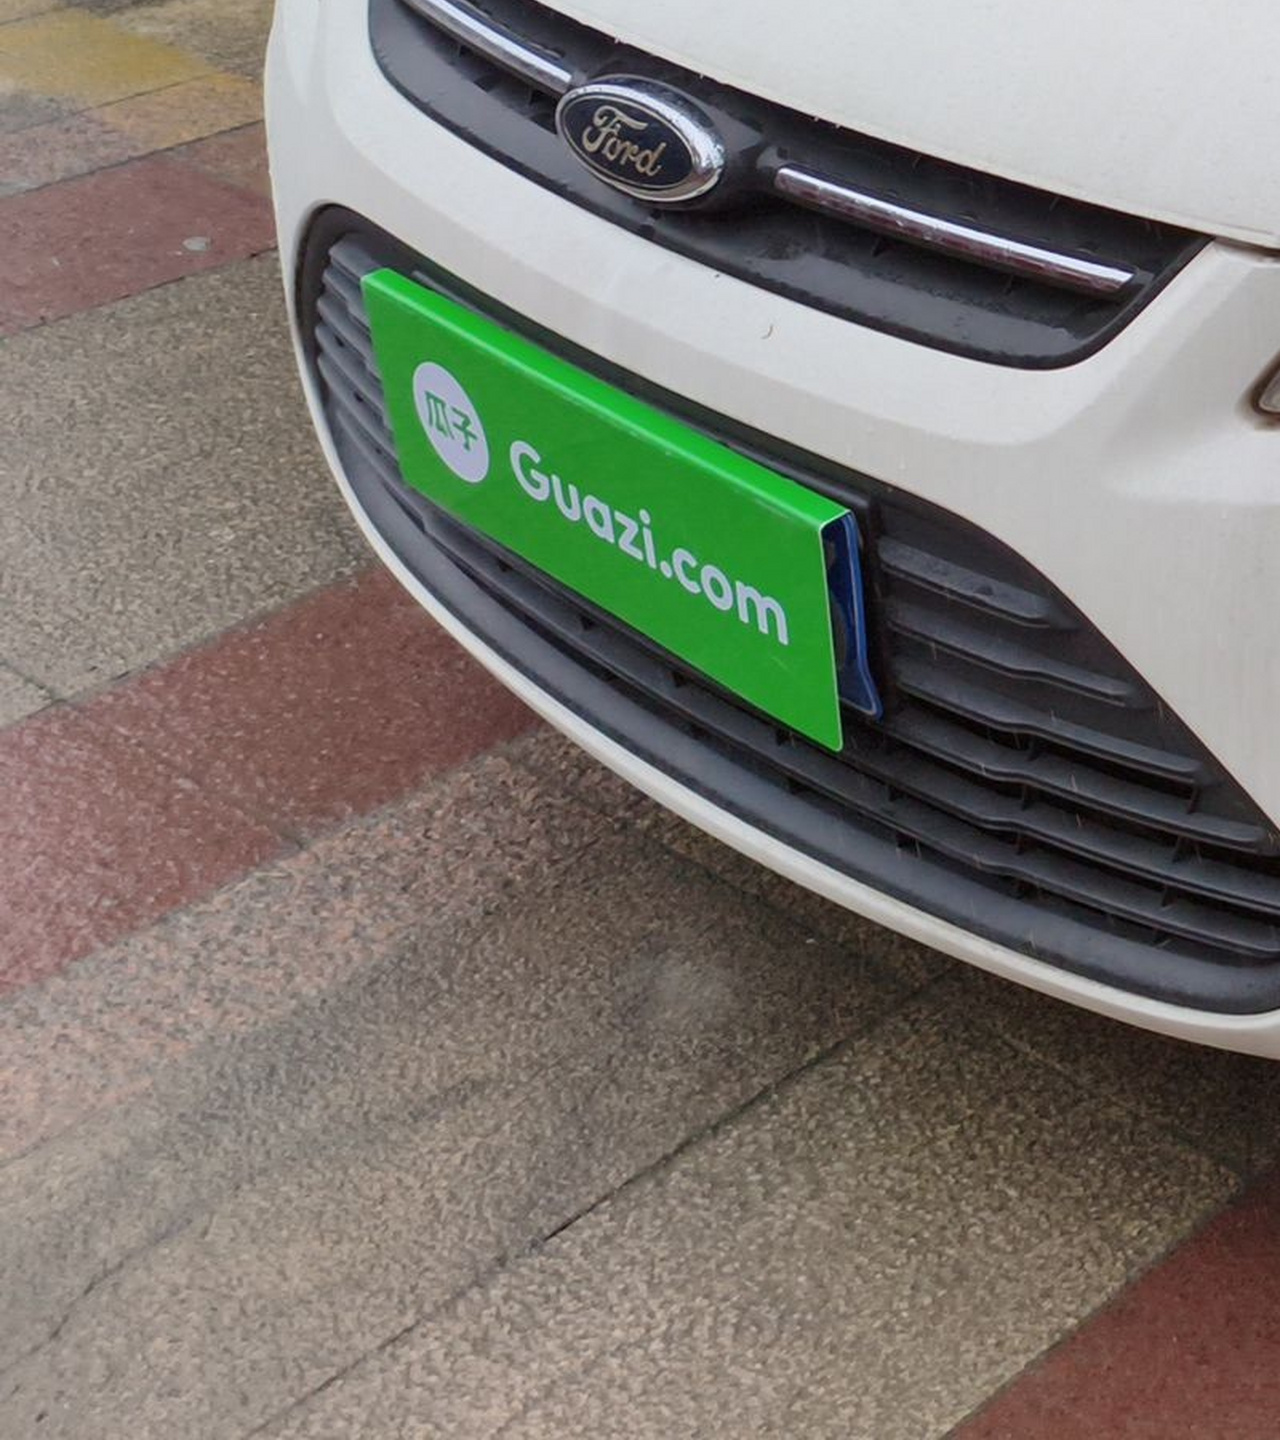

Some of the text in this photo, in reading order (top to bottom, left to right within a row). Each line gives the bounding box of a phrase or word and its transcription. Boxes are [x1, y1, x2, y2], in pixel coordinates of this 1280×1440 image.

[581, 105, 667, 176] Ford
[424, 389, 479, 452] 瓜子
[509, 440, 789, 646] Guazi.com
